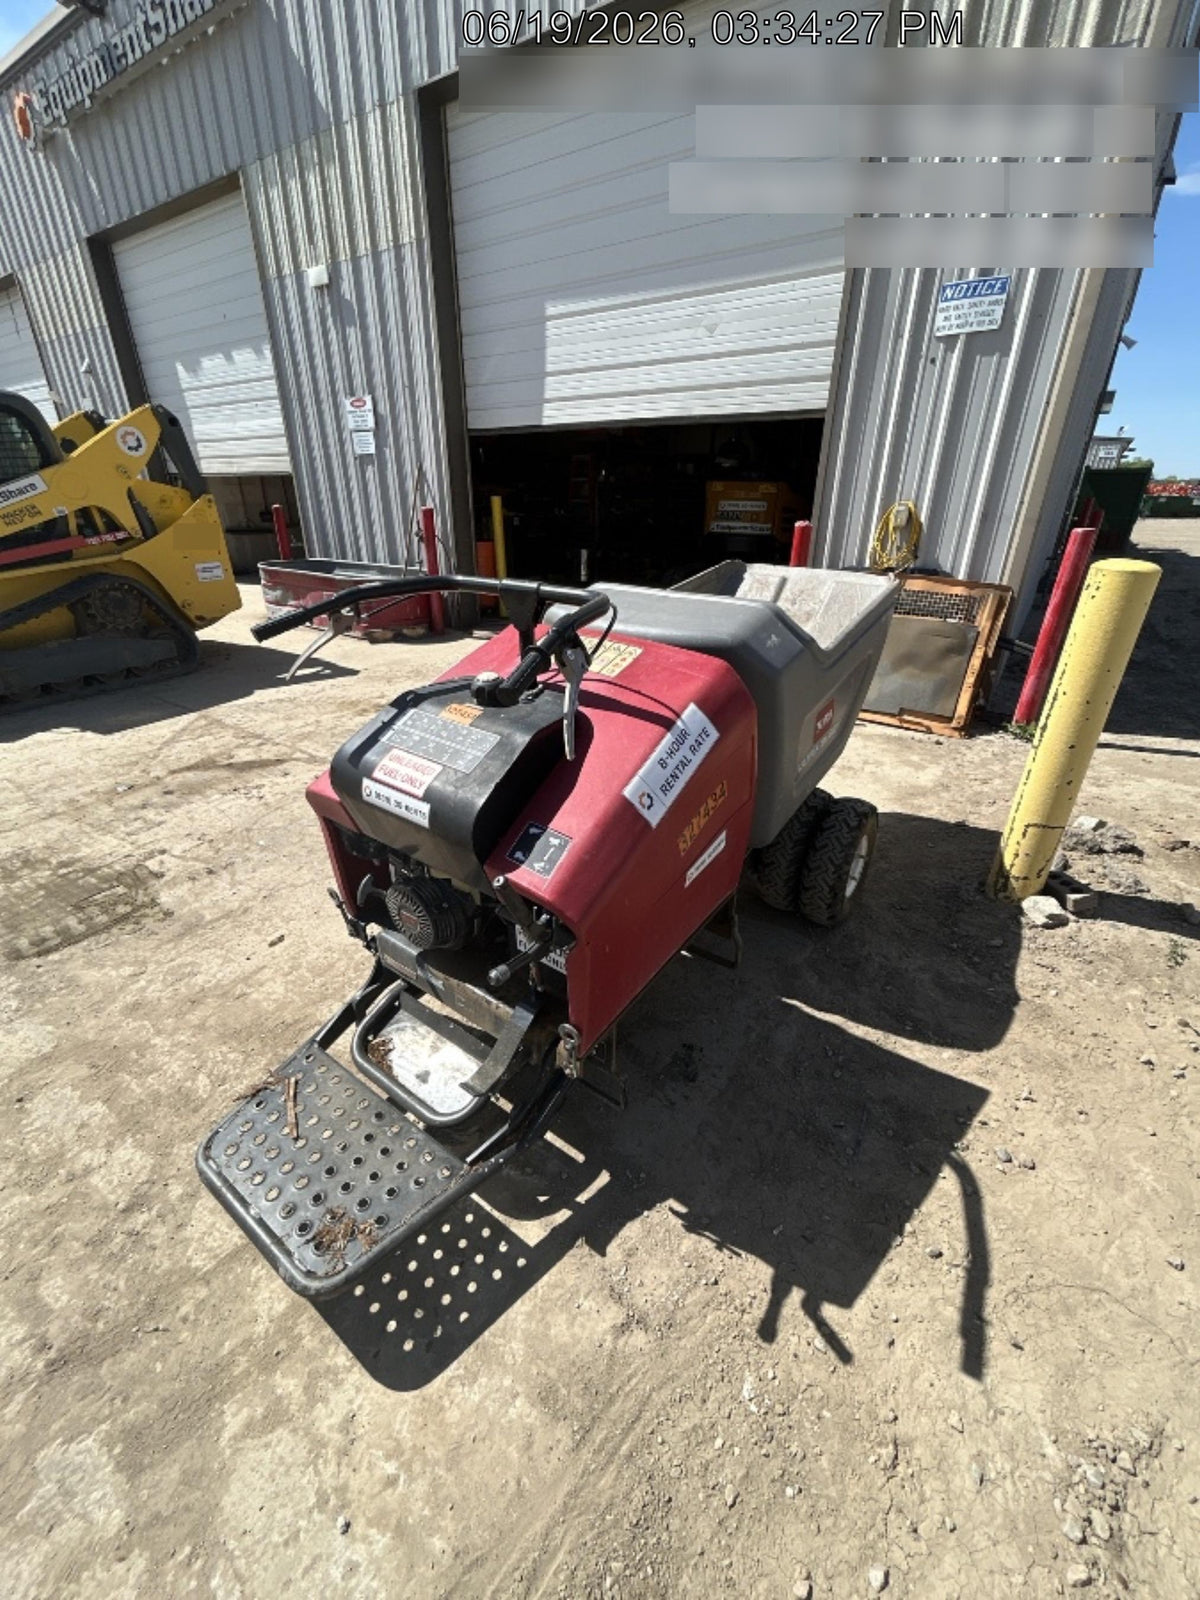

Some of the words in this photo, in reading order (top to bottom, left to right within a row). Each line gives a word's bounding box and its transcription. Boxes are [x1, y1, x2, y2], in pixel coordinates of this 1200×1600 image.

[942, 278, 1007, 301] NOTICE
[0, 483, 38, 503] Share
[657, 728, 691, 770] 8-HOUR
[389, 752, 437, 777] UNLEADED
[659, 755, 692, 797] RENTAL
[689, 726, 711, 756] RATE
[400, 772, 427, 791] ONLY
